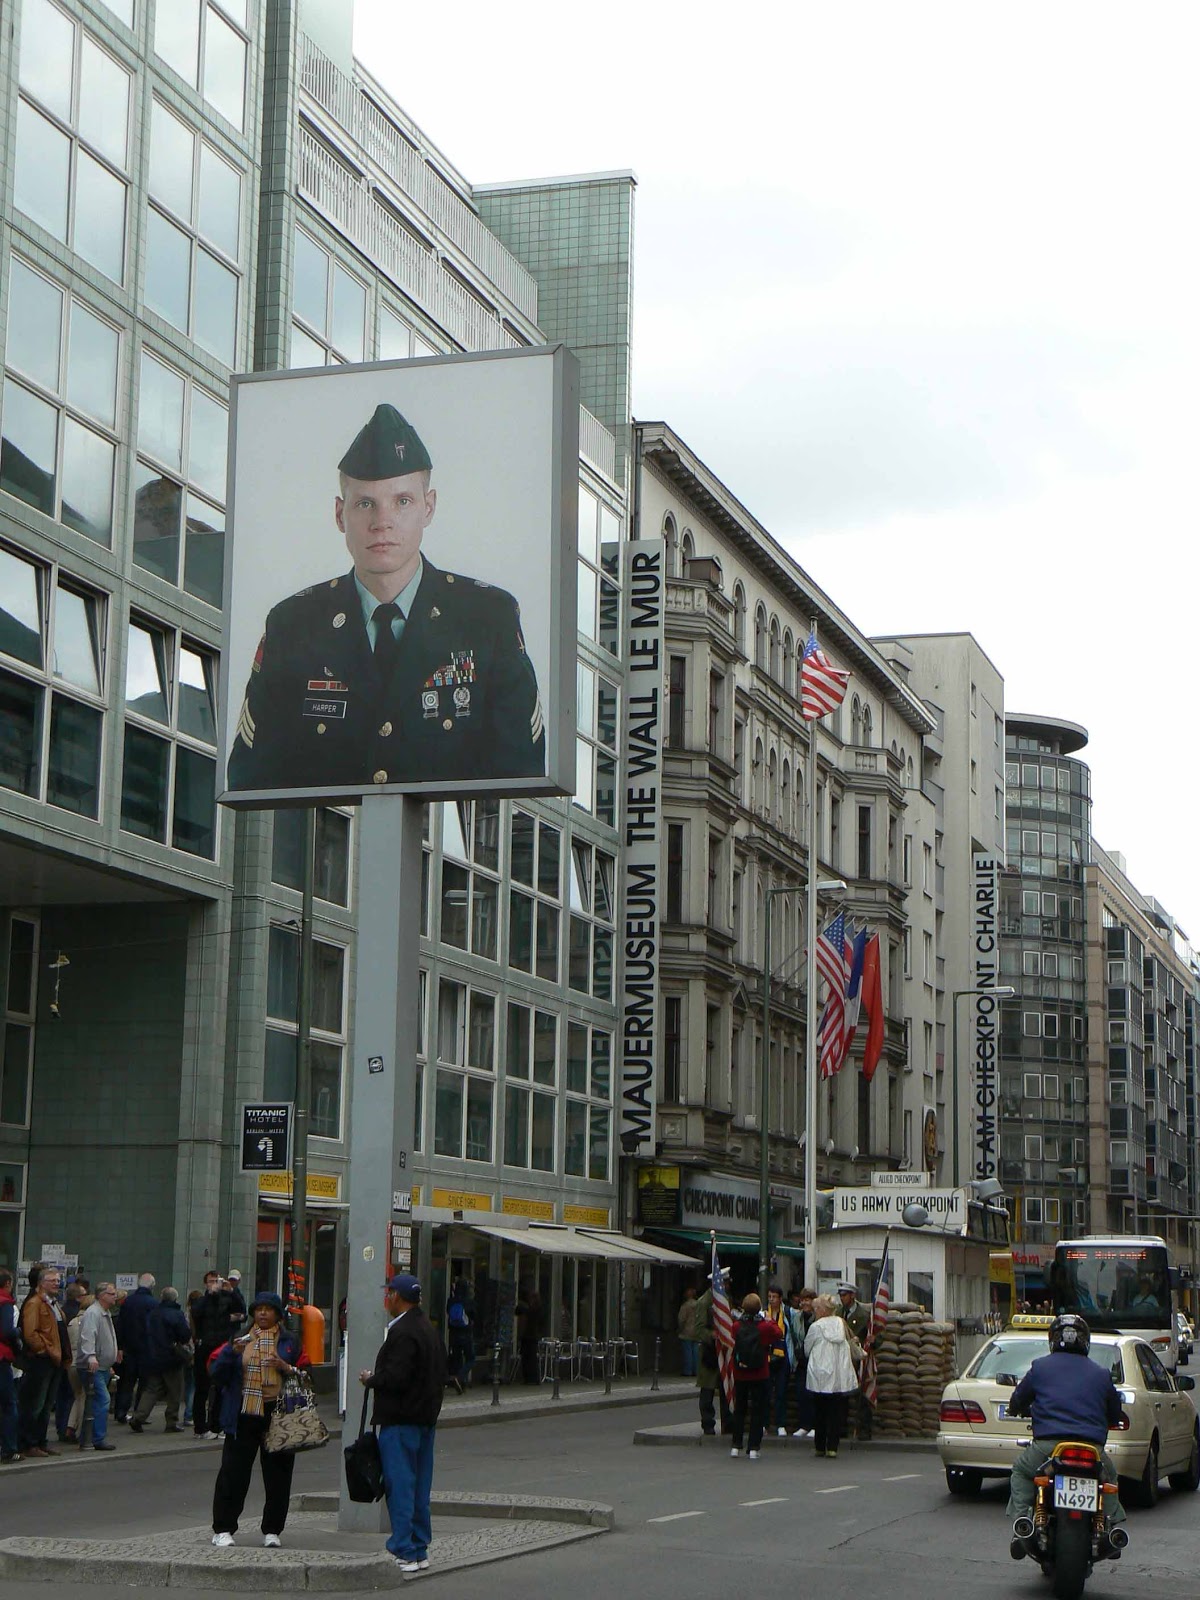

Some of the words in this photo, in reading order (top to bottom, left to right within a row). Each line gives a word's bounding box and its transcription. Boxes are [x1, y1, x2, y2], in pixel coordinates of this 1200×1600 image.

[631, 552, 661, 628] MUR
[630, 638, 659, 671] LE
[312, 703, 337, 713] HARPER
[628, 687, 658, 778] WALL
[626, 786, 656, 847] THE
[976, 859, 995, 953] CHARLIE
[623, 863, 656, 1142] MAUERMUSEUM
[976, 960, 995, 1108] CHECKPONT
[246, 1109, 286, 1117] TITANIC
[976, 1114, 995, 1154] AM
[878, 1174, 893, 1184] ALLIED
[894, 1174, 922, 1184] CHECKPOINT
[448, 1195, 463, 1207] SINCE
[684, 1187, 735, 1218] CHECKPOINT
[735, 1194, 760, 1221] CHARL
[862, 1195, 892, 1213] ARMY
[1018, 1316, 1048, 1324] TAXI
[1057, 1491, 1096, 1509] N497
[1069, 1478, 1078, 1491] B
